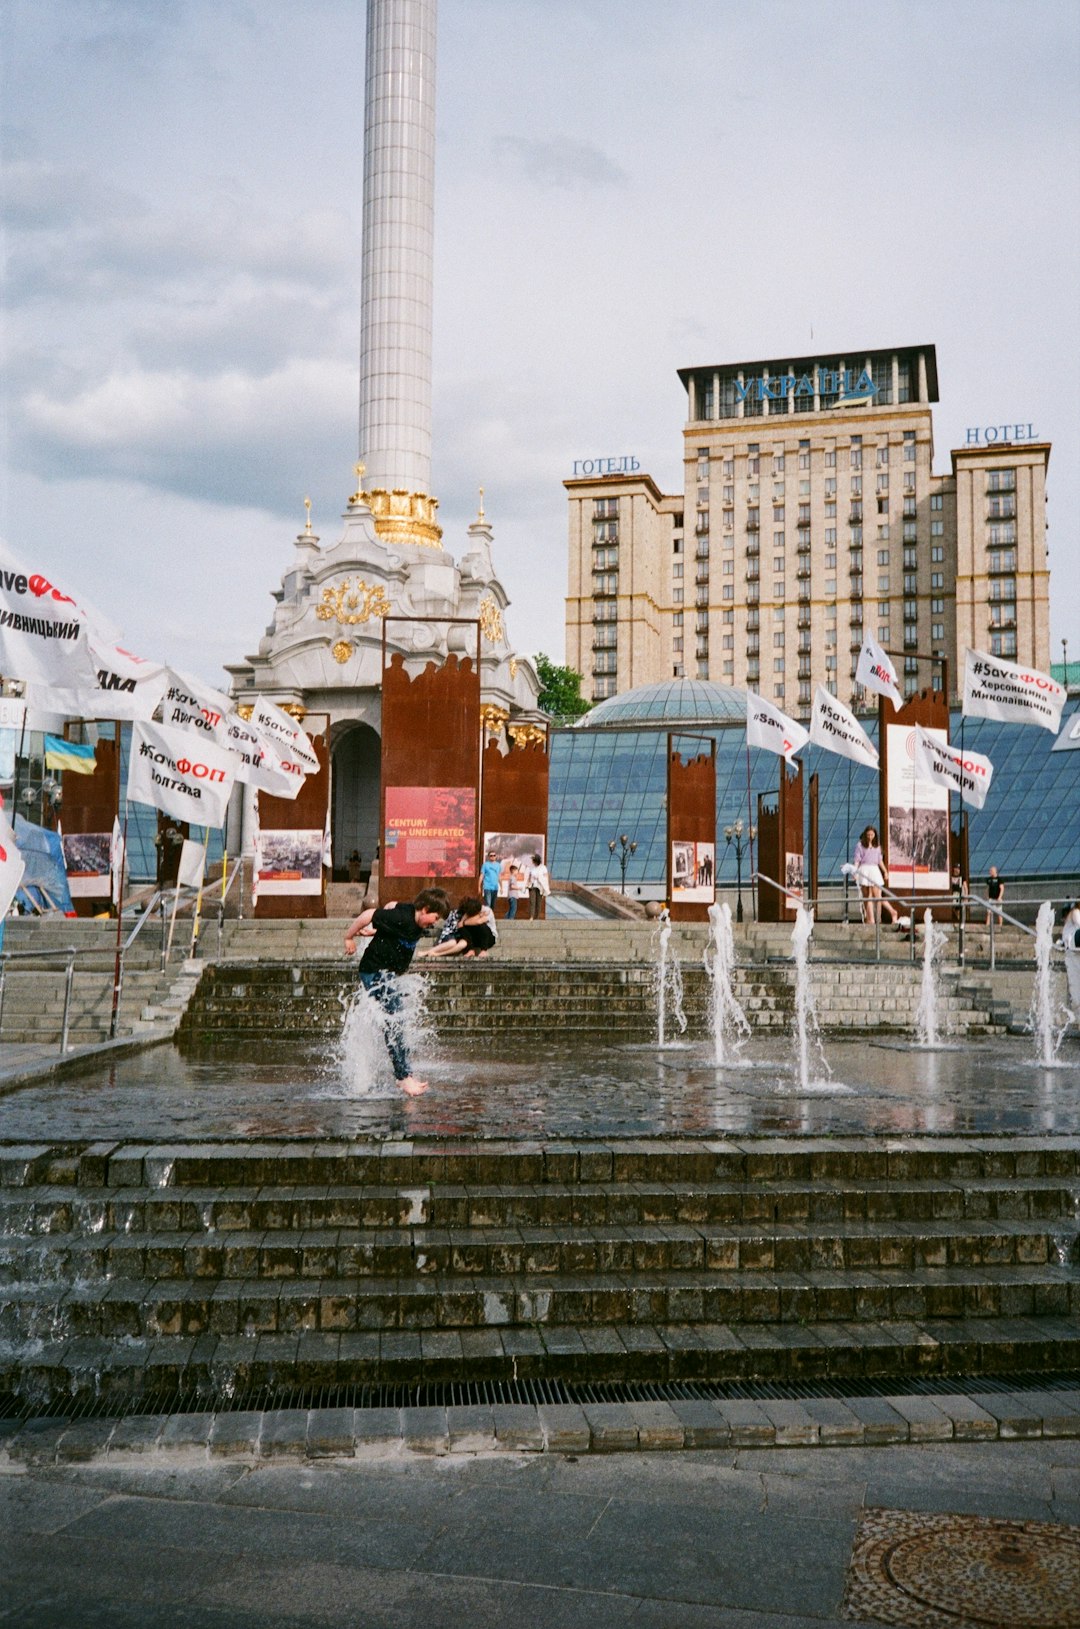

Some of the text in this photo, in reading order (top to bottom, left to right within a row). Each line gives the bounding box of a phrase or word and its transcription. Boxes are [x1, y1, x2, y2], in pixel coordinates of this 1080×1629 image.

[733, 368, 877, 403] УКРАЇНА
[966, 424, 1039, 444] HOTEL
[573, 456, 640, 475] ГОТЕЛЬ
[388, 818, 428, 827] CENTURY
[409, 828, 465, 837] UNDEFEATED
